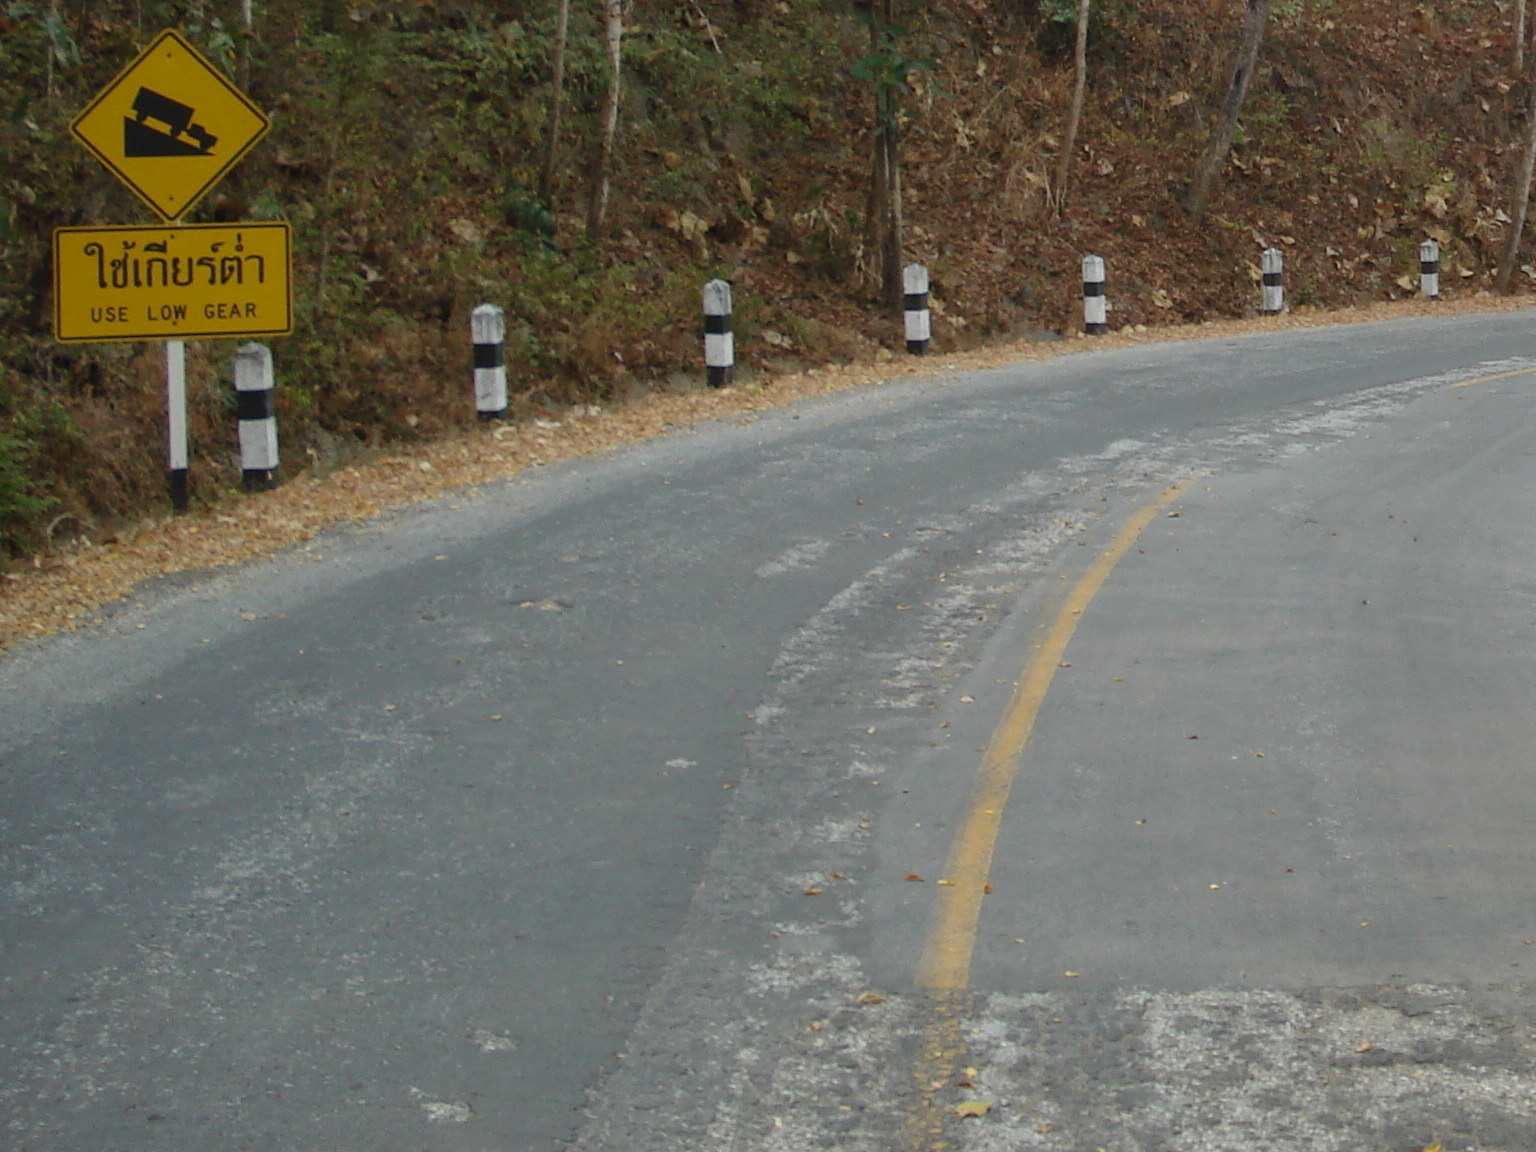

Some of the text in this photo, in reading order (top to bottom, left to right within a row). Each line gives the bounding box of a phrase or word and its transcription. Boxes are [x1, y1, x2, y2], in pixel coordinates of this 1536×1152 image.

[83, 232, 265, 289] ใช้เกียร์ต่ำ
[90, 302, 257, 323] USE LOW GEAR
